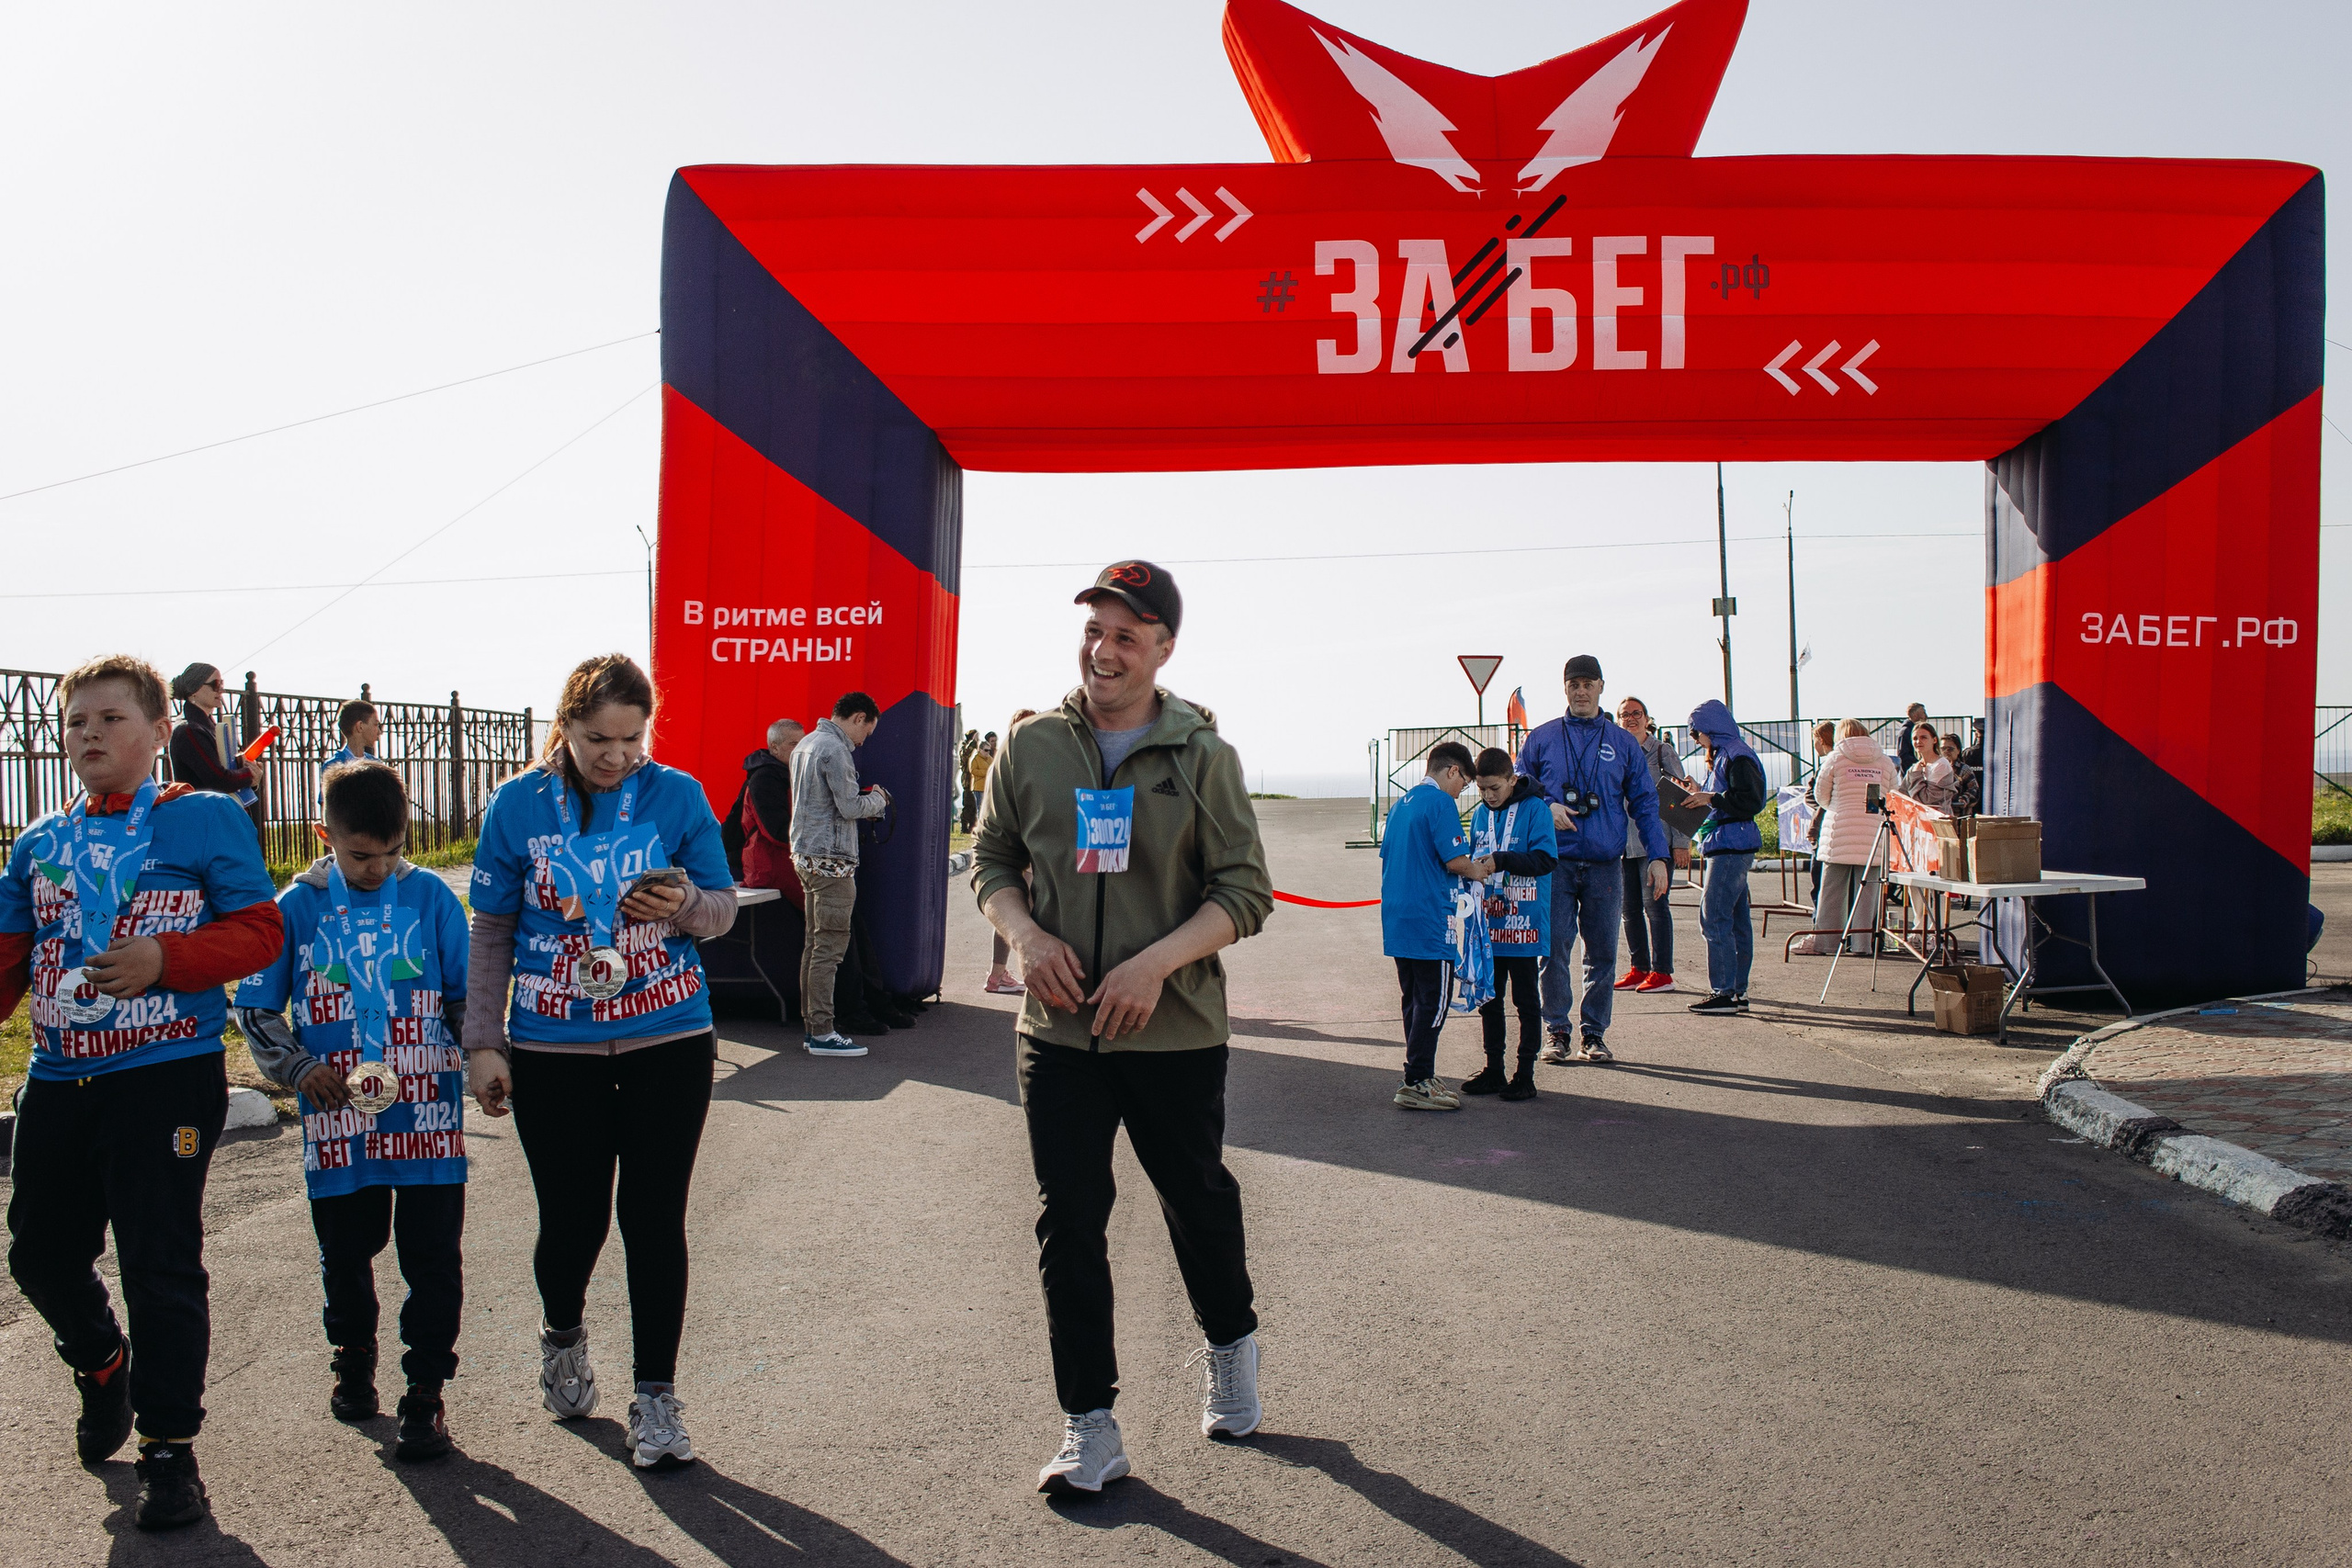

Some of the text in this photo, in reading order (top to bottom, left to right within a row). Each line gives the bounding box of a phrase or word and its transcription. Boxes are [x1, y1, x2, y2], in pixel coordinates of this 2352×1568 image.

[684, 600, 883, 629] В ритме всей
[2080, 612, 2298, 648] ЗАБЕГ.РФ
[711, 637, 853, 663] СТРАНЫ!
[1151, 785, 1180, 797] adidas
[130, 889, 205, 918] #ЦЕЛЬ
[1504, 915, 1531, 930] 2024
[114, 993, 179, 1029] 2024
[60, 1016, 198, 1058] #ЕДИНСТВО
